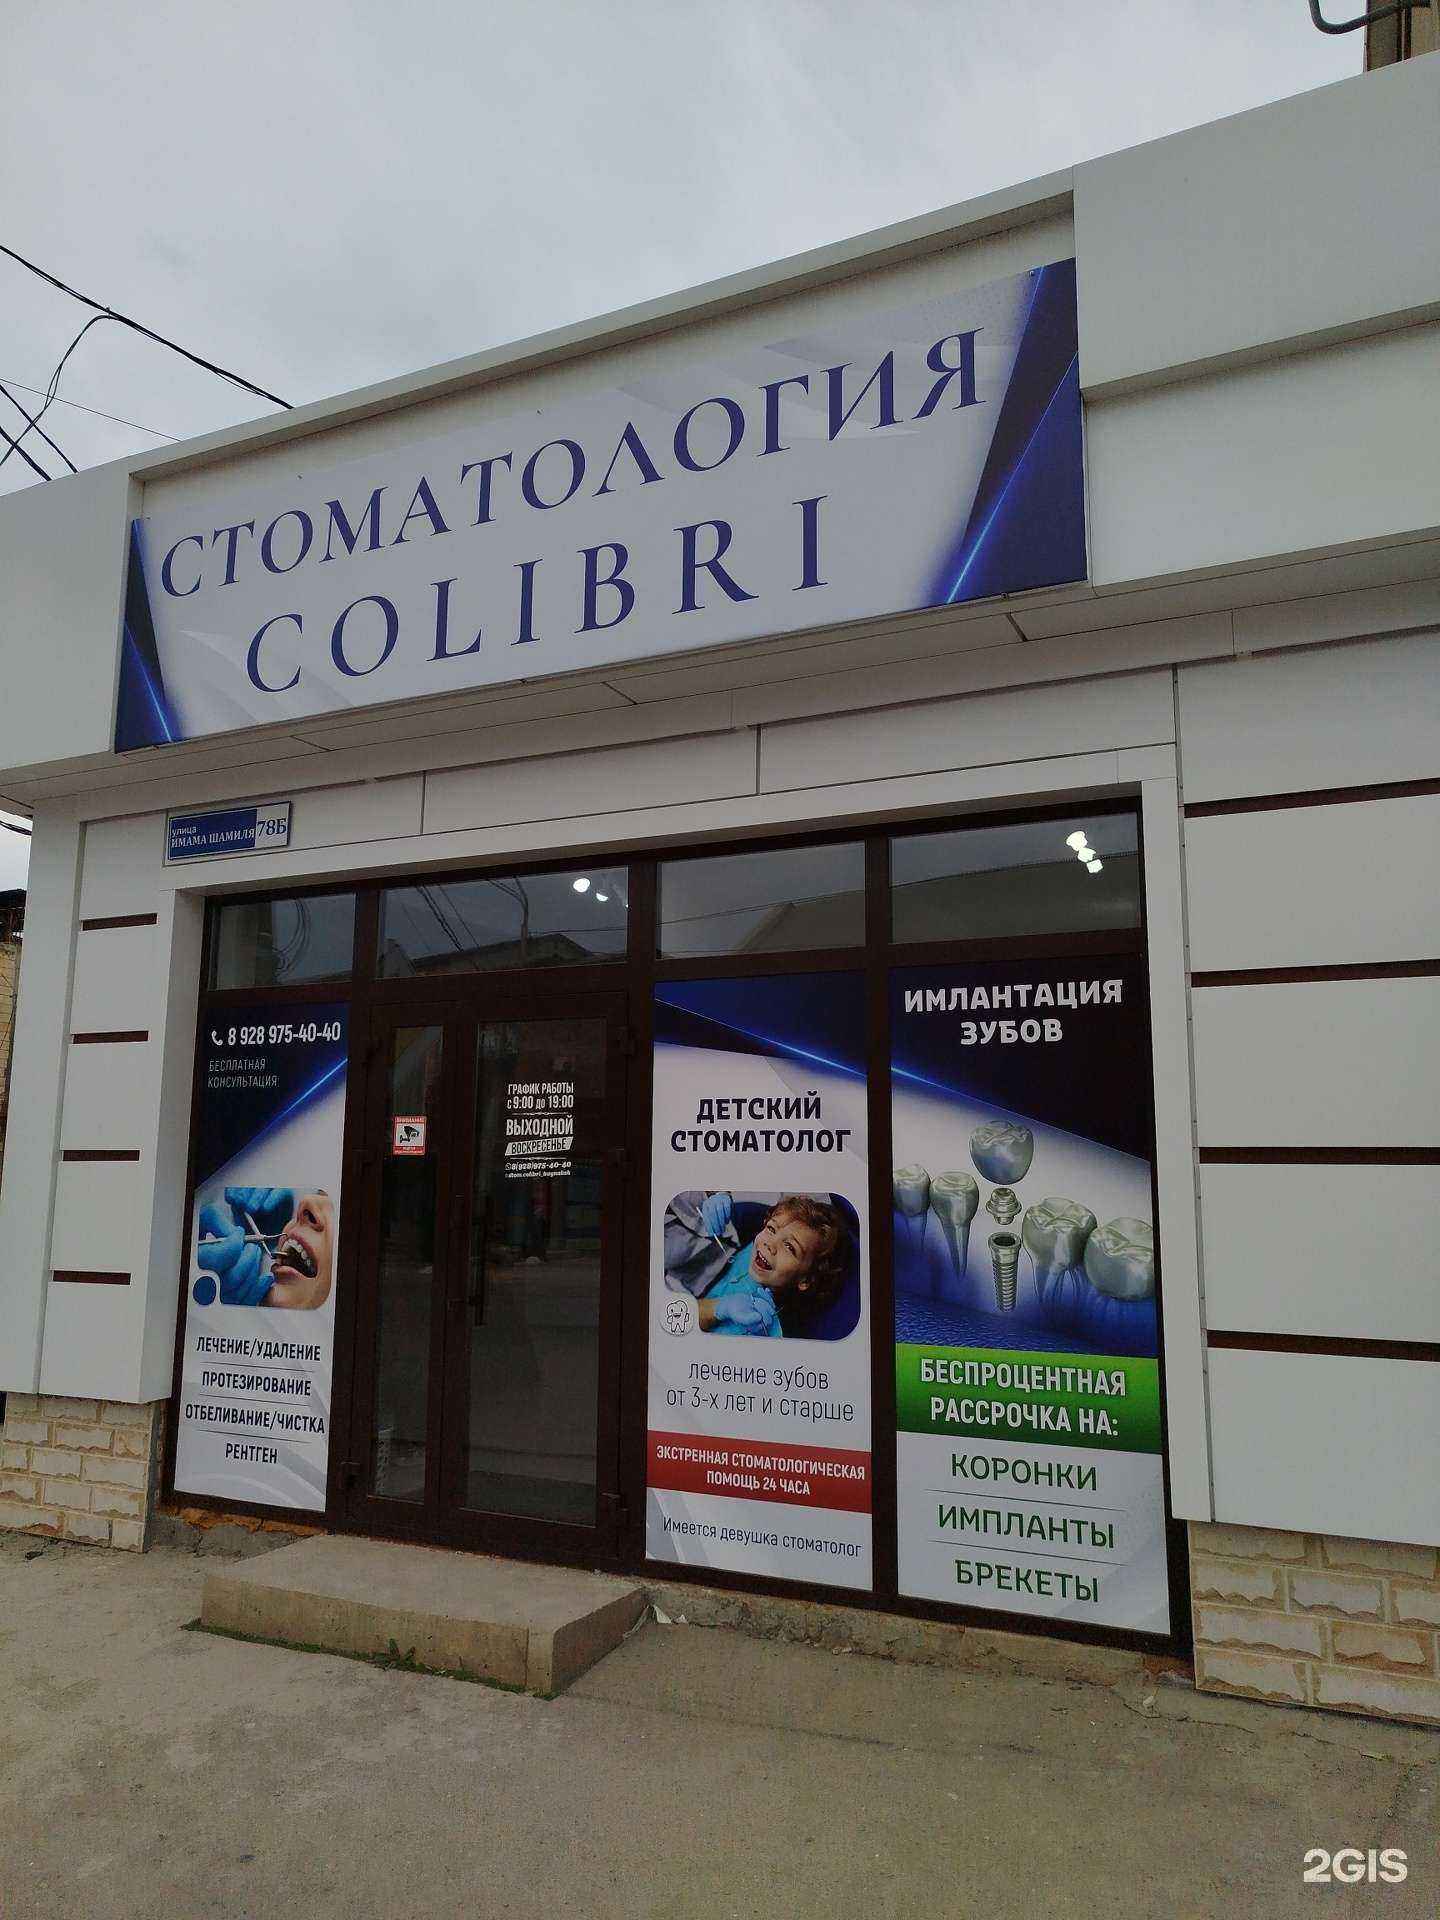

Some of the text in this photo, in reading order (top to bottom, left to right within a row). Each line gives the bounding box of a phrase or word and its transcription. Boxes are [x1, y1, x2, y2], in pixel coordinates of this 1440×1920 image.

[161, 327, 985, 598] СТОМАТОЛОГИЯ
[246, 494, 829, 693] COLIBRI
[171, 826, 197, 838] улица
[171, 828, 255, 848] ИМАМА ШАМИЛЯ
[257, 818, 287, 837] 78Б
[904, 979, 1123, 1013] ИМЛАНТАЦИЯ
[227, 1021, 341, 1046] 8 928 975-40-40
[960, 1018, 1063, 1045] ЗУБОВ
[209, 1058, 266, 1072] БЕСПЛАТНАЯ
[507, 1082, 574, 1095] ГРАФИК РАБОТЫ
[513, 1095, 534, 1109] 9:00
[536, 1098, 546, 1109] до
[548, 1094, 574, 1108] 19:00
[696, 1090, 821, 1124] ДЕТСКИЙ
[506, 1114, 574, 1137] ВЫХОДНОЙ
[511, 1138, 567, 1154] ВОСКРЕСЕНЬЕ
[670, 1129, 851, 1152] СТОМАТОЛОГ
[196, 1336, 321, 1361] ЛЕЧЕНИЕ/УДАЛЕНИЕ
[202, 1371, 312, 1396] ПРОТЕЗИРОВАНИЕ
[688, 1362, 829, 1391] лечение зубов
[920, 1358, 1126, 1396] БЕСПРОЦЕНТНАЯ
[666, 1386, 854, 1423] от 3-х лет и старше
[930, 1396, 1119, 1436] РАССРОЧКА НА:
[185, 1403, 326, 1434] ОТБЕЛИВАНИЕ/ЧИСТКА
[225, 1443, 278, 1464] РЕНТГЕН
[656, 1445, 865, 1481] ЭКСТРЕННАЯ СТОМАТОЛОГИЧЕСКАЯ
[706, 1470, 811, 1496] ПОМОЩЬ 24 ЧАСА
[951, 1453, 1097, 1491] КОРОНКИ
[663, 1516, 863, 1557] Имеется девушка стоматолог
[937, 1503, 1115, 1549] ИМПЛАНТЫ
[954, 1559, 1099, 1602] БРЕКЕТЫ
